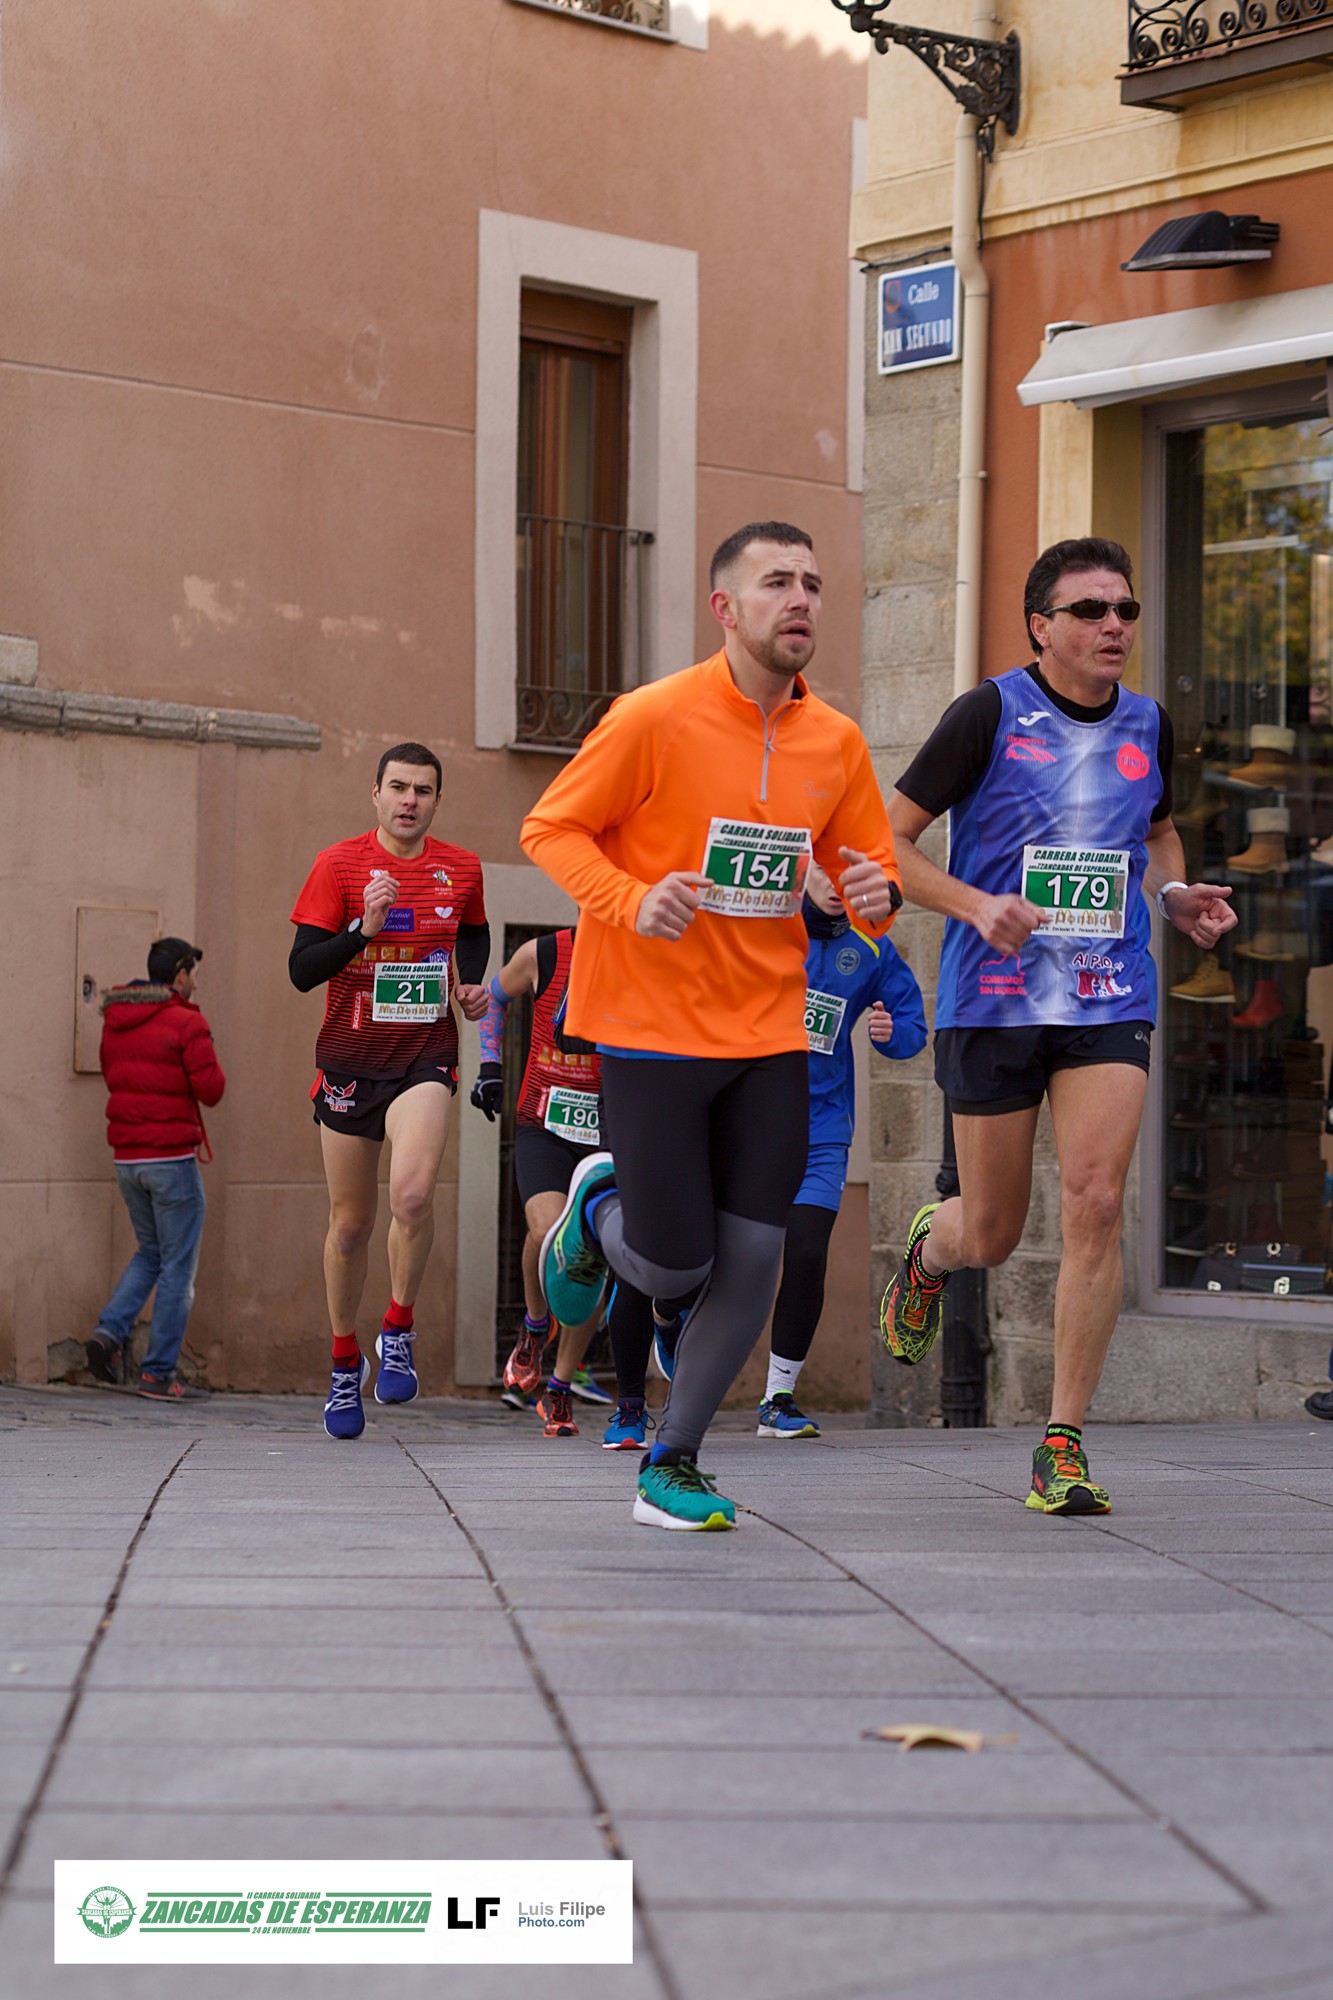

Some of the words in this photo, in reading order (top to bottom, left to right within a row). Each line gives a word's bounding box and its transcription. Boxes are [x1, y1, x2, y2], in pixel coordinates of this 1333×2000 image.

[908, 281, 939, 304] Calle
[720, 824, 764, 839] CARRERA
[1033, 850, 1077, 862] CARRERA
[1078, 852, 1122, 864] SOLIDARIA
[729, 851, 790, 889] 154
[1047, 874, 1110, 908] 179
[980, 975, 1024, 985] CORREMOS
[396, 981, 425, 1003] 21
[980, 986, 993, 994] SIN
[803, 1008, 828, 1033] 61
[556, 1090, 582, 1100] CARRERA
[330, 1104, 347, 1112] TEAM
[561, 1105, 599, 1129] 190
